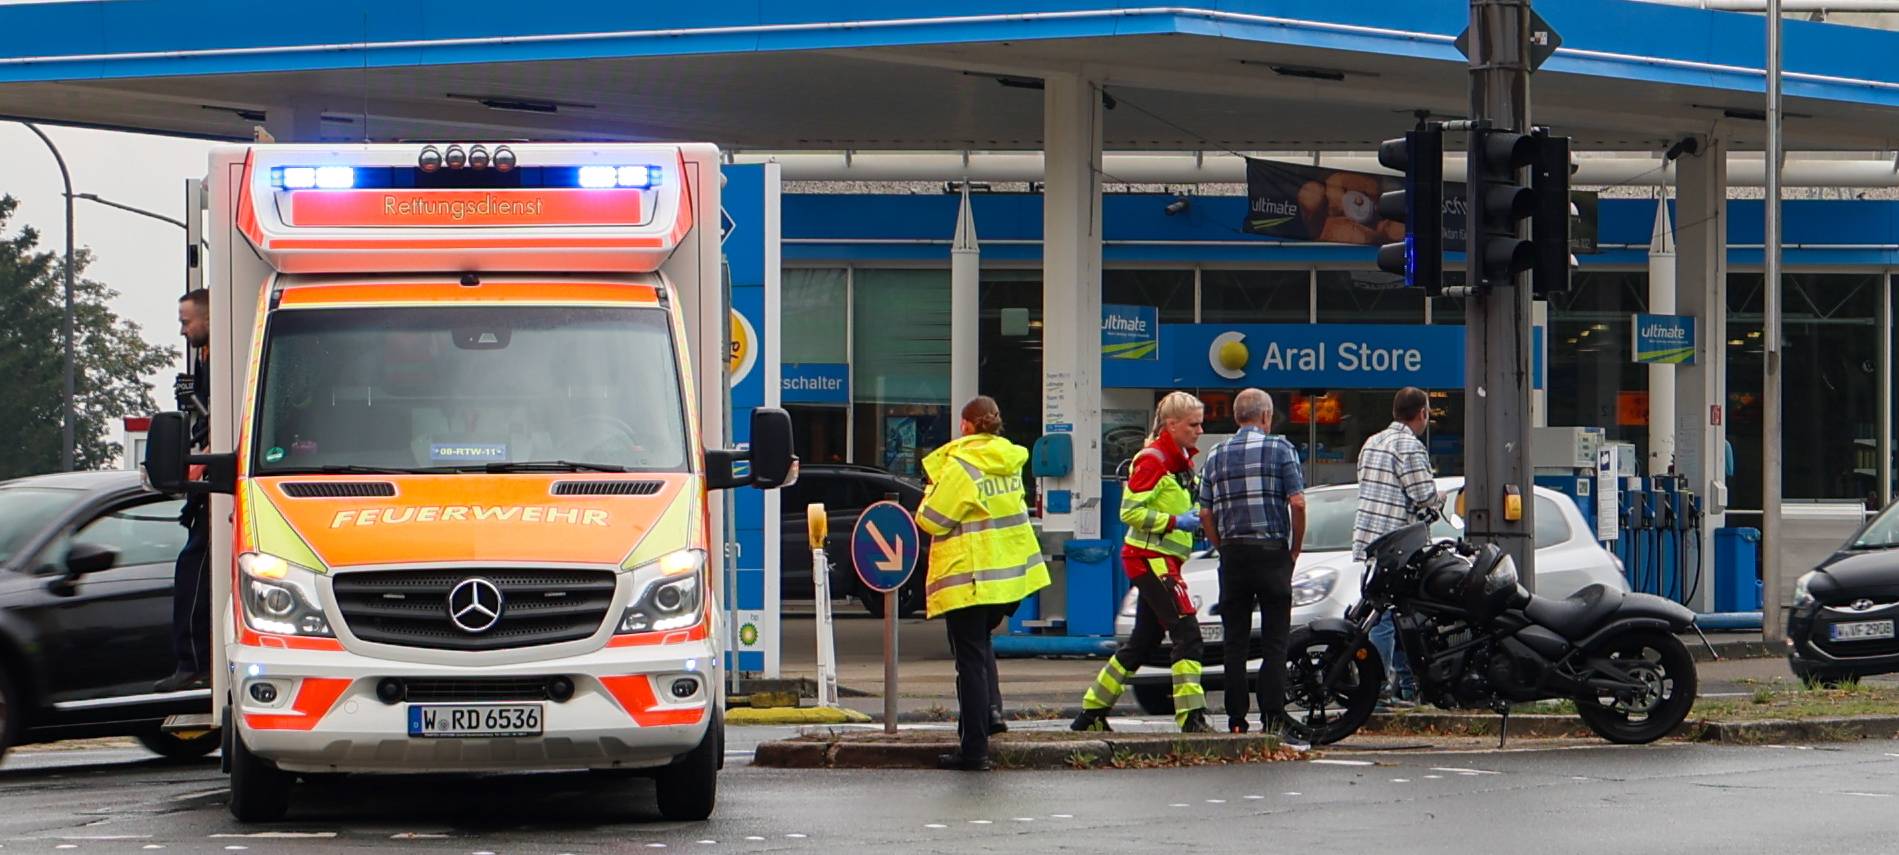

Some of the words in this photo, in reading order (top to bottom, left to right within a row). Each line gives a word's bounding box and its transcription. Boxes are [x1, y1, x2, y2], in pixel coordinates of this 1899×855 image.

[383, 193, 542, 221] Rettungsdienst
[1251, 197, 1298, 216] ultimate
[1101, 314, 1146, 331] ultimate
[1641, 324, 1685, 339] ultimate
[1262, 342, 1325, 371] Aral
[1337, 342, 1422, 372] Store
[782, 375, 844, 390] schalter
[329, 505, 611, 529] FEUERWEHR
[424, 709, 437, 730] W
[452, 709, 480, 730] RD
[485, 708, 538, 730] 6536
